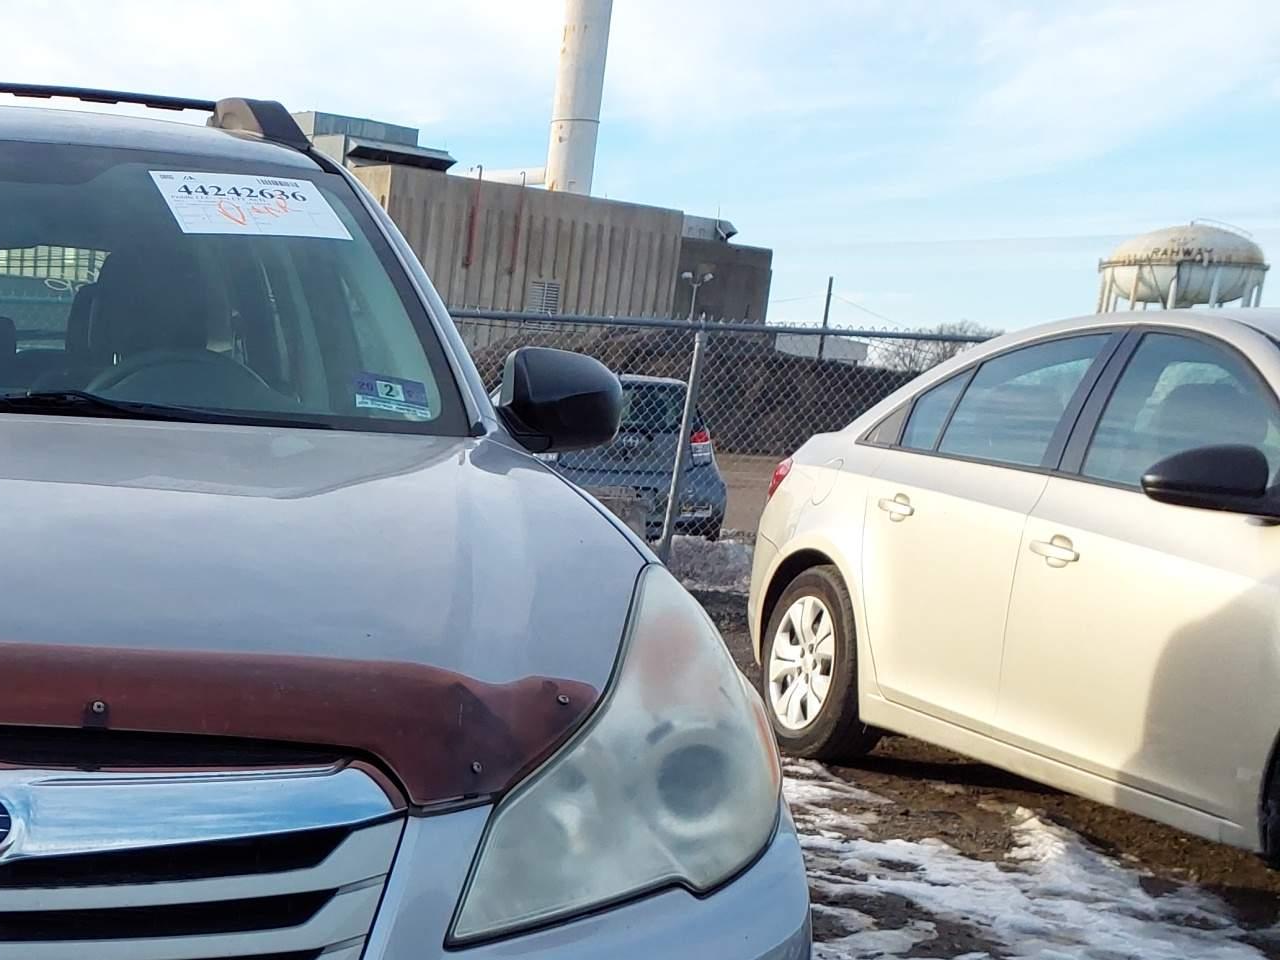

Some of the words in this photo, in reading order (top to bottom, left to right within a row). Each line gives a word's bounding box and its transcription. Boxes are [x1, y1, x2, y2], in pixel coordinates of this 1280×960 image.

[177, 183, 307, 202] 44242636
[1151, 247, 1214, 258] RAHWAY
[383, 383, 396, 398] 2
